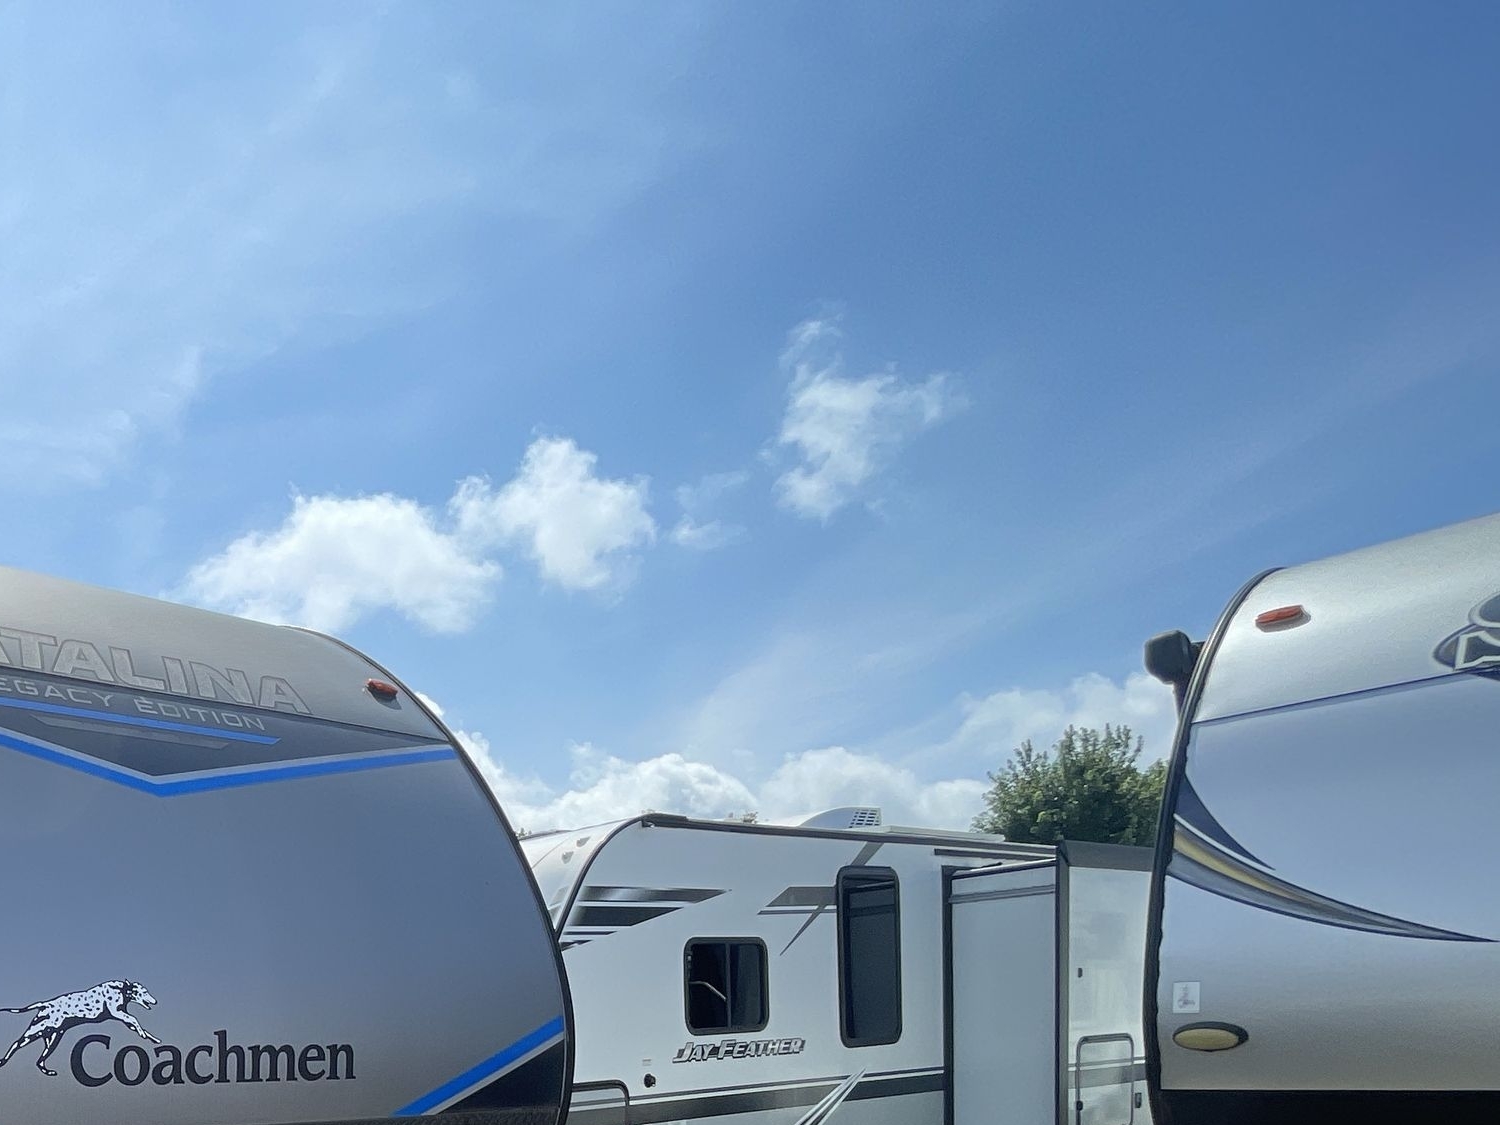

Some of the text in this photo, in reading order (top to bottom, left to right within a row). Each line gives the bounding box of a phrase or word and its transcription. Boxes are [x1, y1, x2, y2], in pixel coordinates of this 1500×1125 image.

[134, 696, 266, 731] EDITION
[70, 1029, 356, 1087] Coachmen
[672, 1037, 806, 1063] JAY FEATHER
